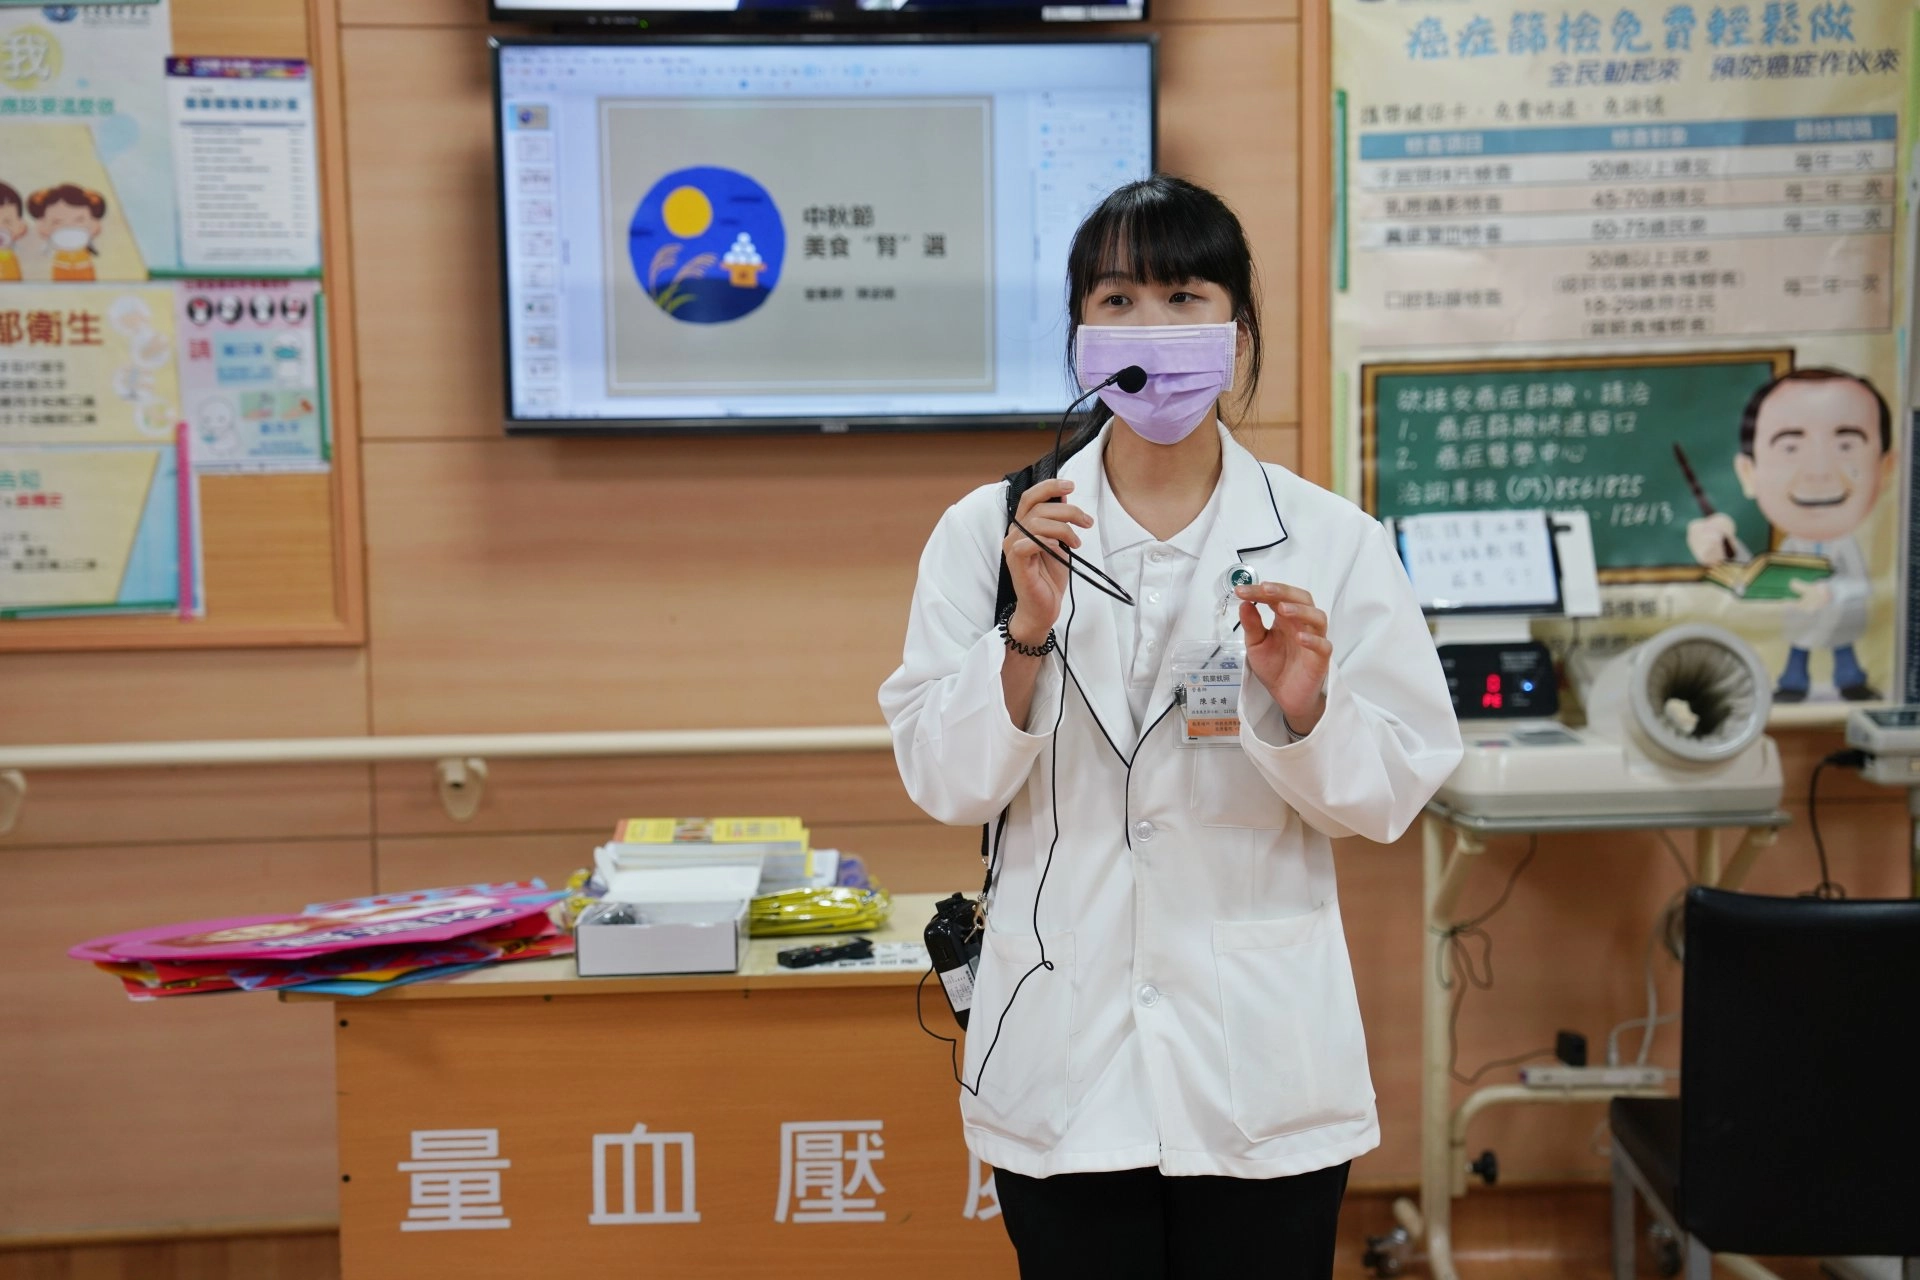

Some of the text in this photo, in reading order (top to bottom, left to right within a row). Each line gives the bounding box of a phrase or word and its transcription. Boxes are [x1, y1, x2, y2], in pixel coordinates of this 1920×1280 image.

[1406, 1, 1856, 61] 癌症篩檢免費輕鬆做
[804, 235, 849, 259] 美食
